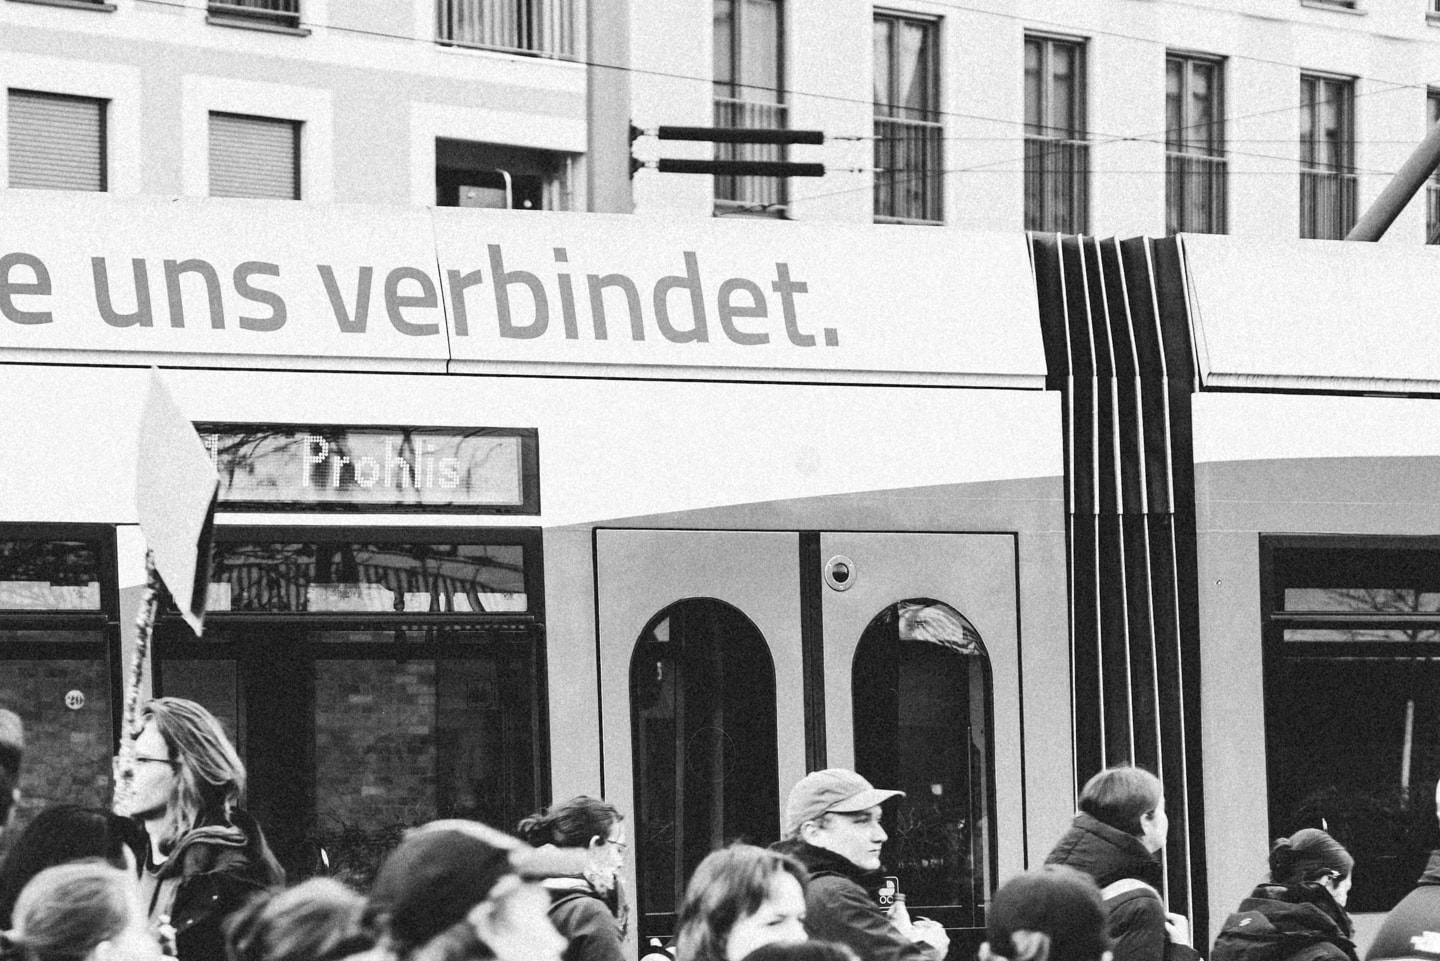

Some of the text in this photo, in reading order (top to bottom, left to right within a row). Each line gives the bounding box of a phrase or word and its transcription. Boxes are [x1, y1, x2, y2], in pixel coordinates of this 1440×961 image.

[90, 256, 288, 332] uns
[317, 243, 841, 347] verbindet.
[303, 435, 460, 488] Prohlis
